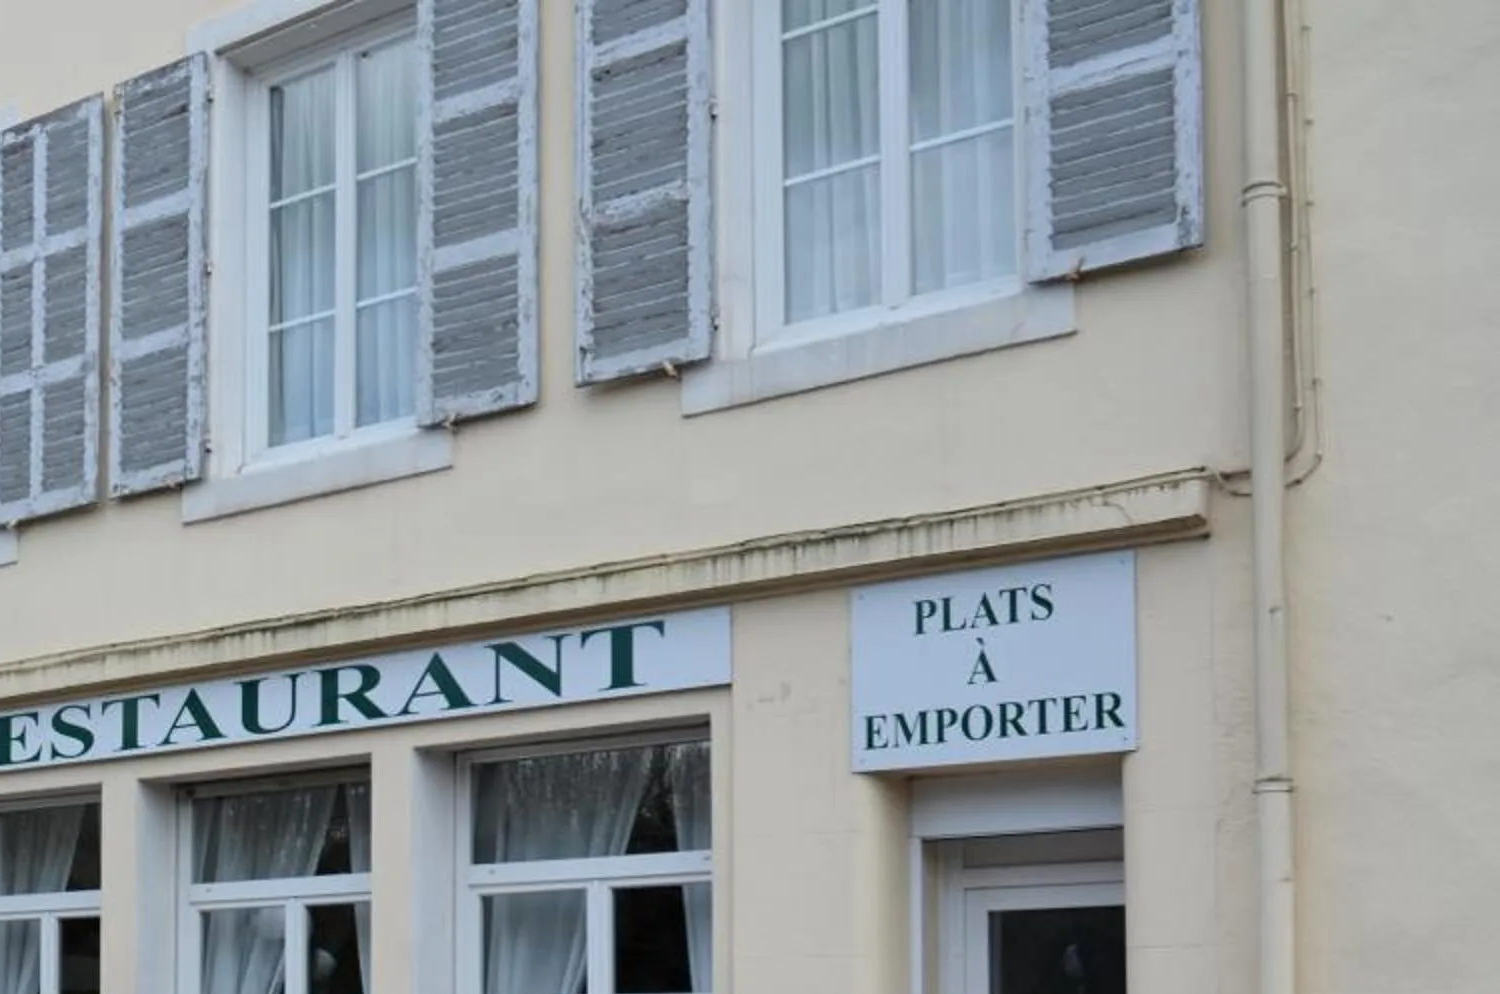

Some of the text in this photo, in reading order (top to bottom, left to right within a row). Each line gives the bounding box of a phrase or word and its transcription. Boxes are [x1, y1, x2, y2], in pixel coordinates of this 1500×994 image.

[914, 583, 1055, 635] PLATS
[967, 637, 998, 685] À
[864, 692, 1125, 750] EMPORTER
